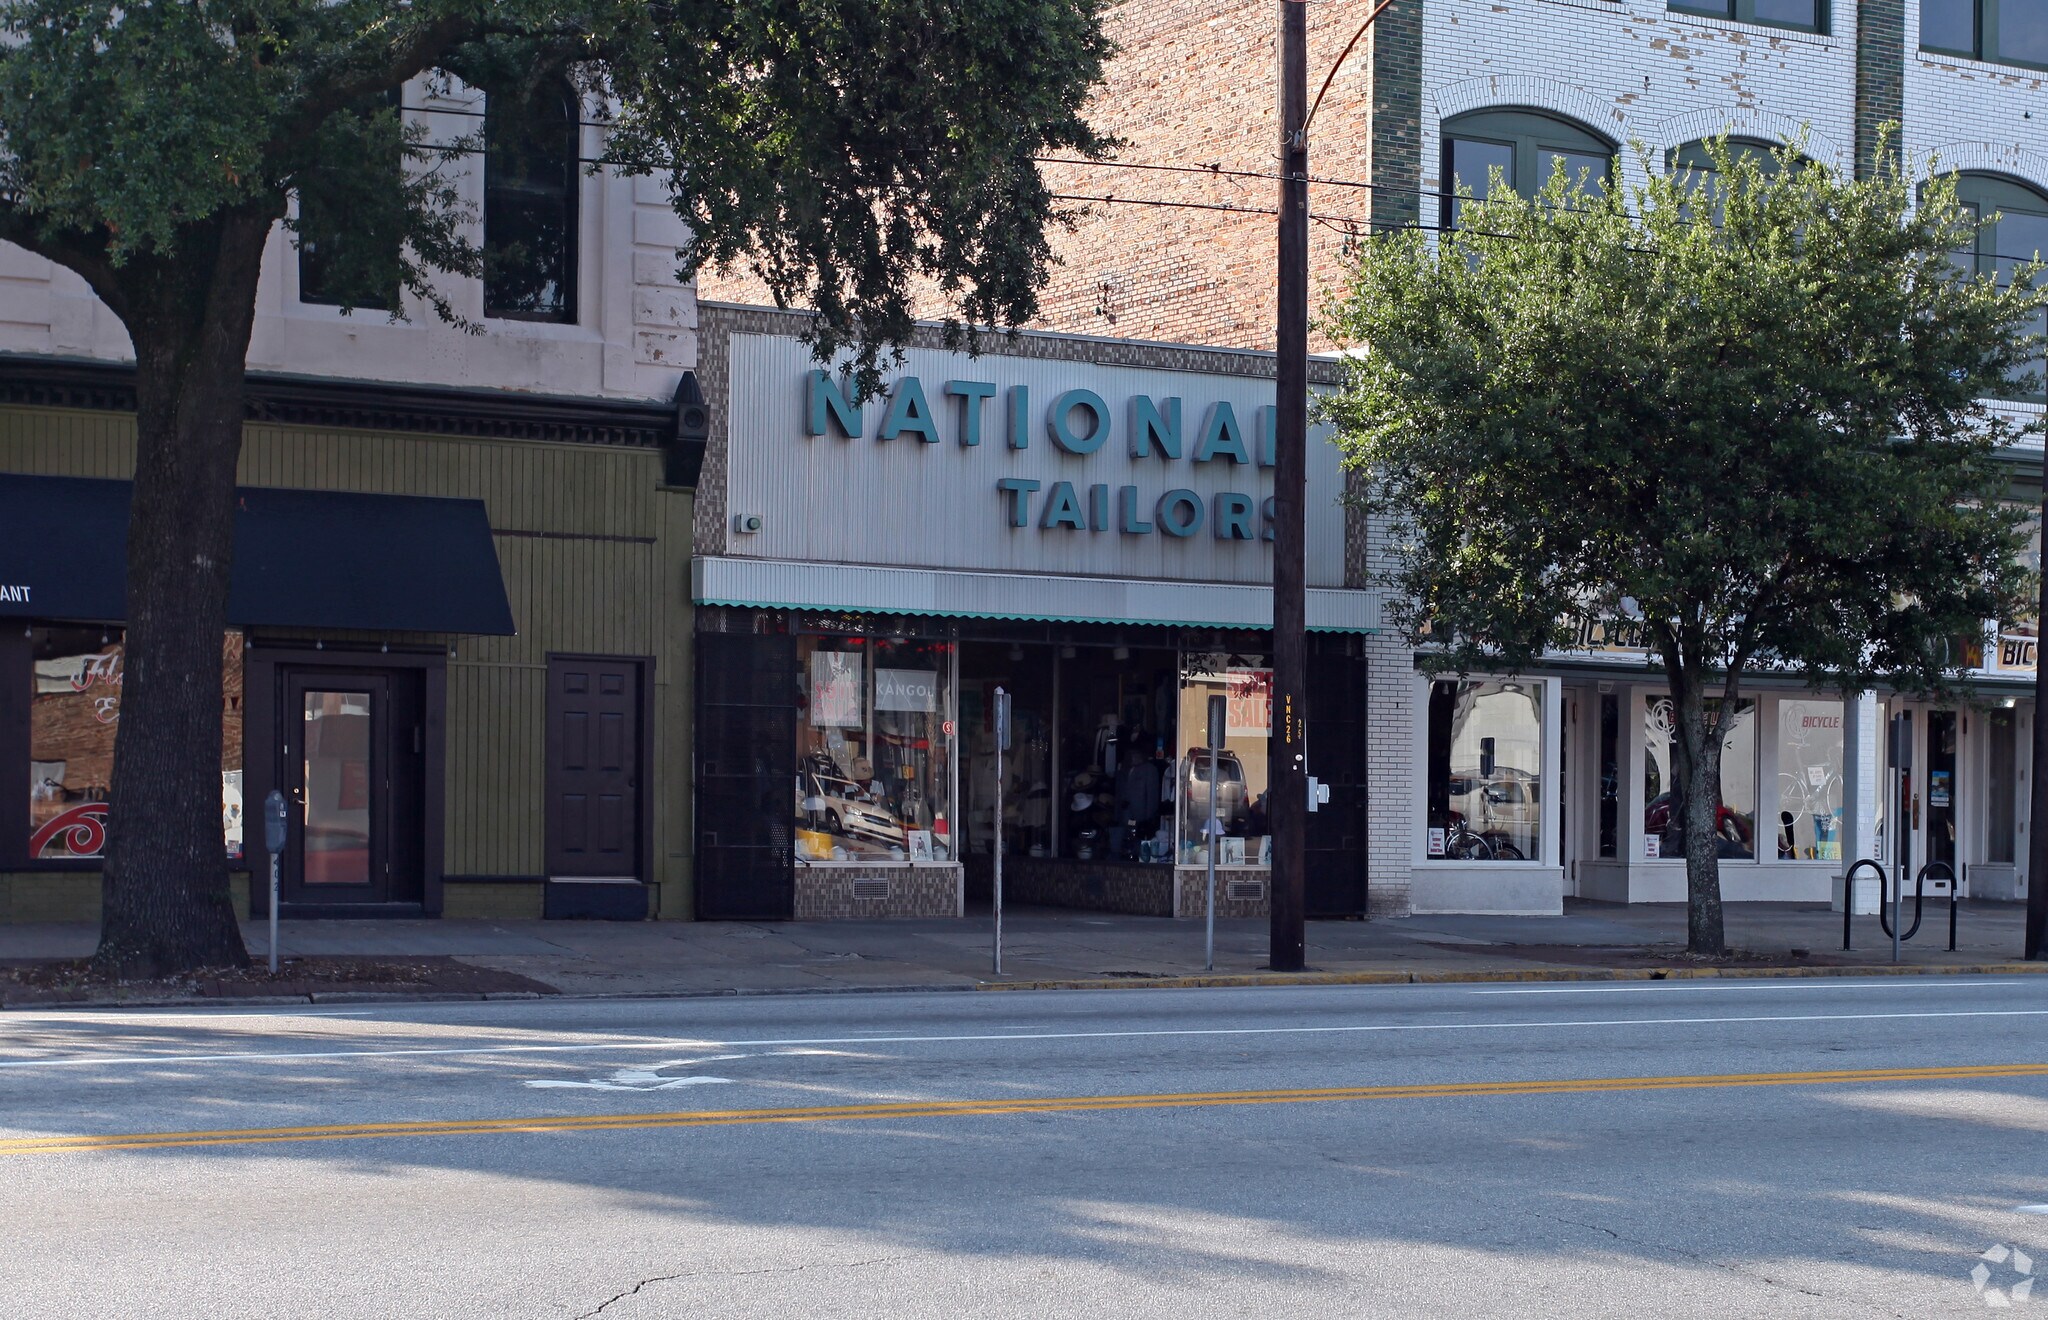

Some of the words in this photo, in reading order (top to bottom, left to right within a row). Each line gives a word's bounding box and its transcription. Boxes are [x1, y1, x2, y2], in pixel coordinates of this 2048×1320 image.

[876, 683, 934, 698] KANGOL
[1228, 700, 1272, 728] SALE
[1802, 716, 1840, 728] BICYCLE
